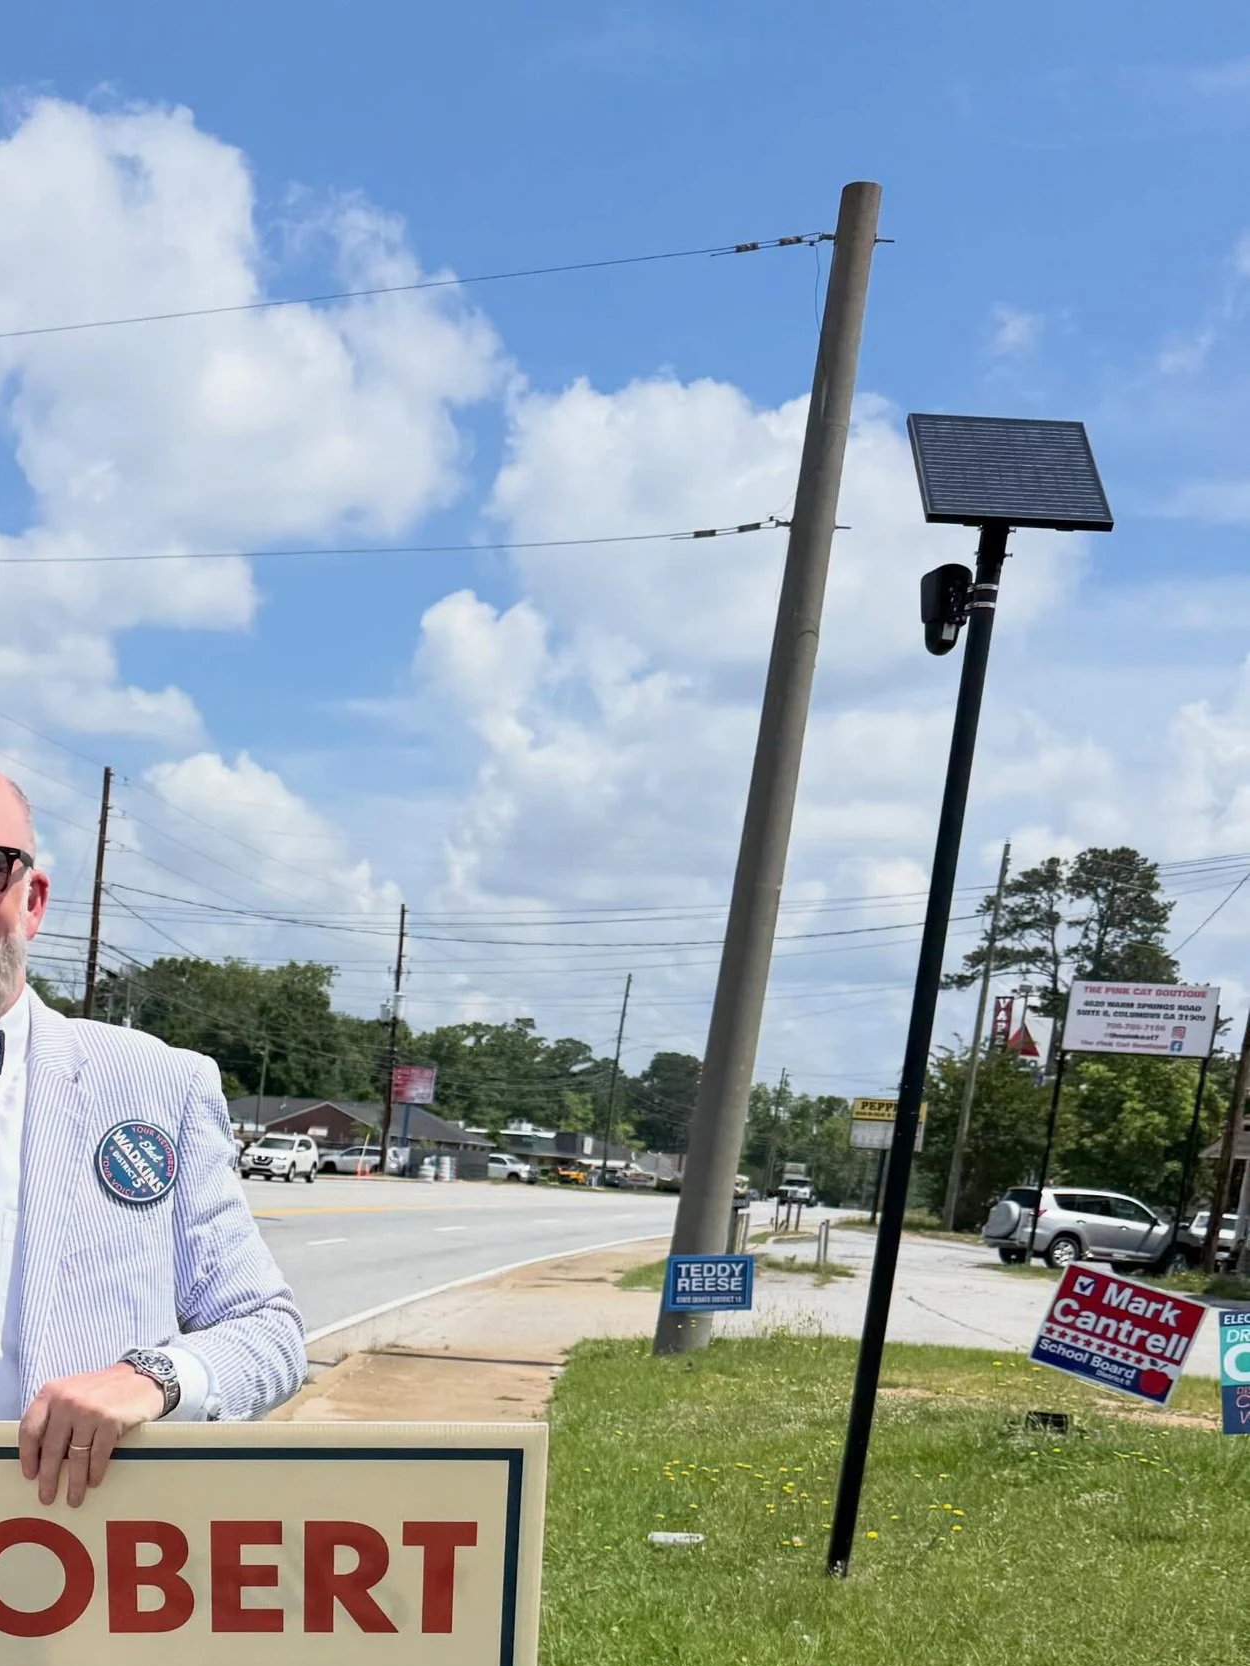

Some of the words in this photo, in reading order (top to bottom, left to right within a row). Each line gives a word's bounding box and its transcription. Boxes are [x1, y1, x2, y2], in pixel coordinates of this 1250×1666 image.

[1084, 985, 1102, 994] THE
[1133, 988, 1153, 996] CAT
[1155, 989, 1207, 998] BOUTIQUE
[1113, 1011, 1161, 1019] COLUMBUS
[112, 1129, 165, 1193] WADKINS
[139, 1140, 164, 1163] Elect
[112, 1151, 138, 1179] DISTRICT
[132, 1177, 145, 1189] 5
[676, 1263, 744, 1278] TEDDY
[676, 1277, 743, 1292] REESE
[1102, 1282, 1181, 1327] Mark
[1053, 1298, 1190, 1361] Cantrell
[1038, 1337, 1089, 1364] School
[1090, 1354, 1137, 1379] Board
